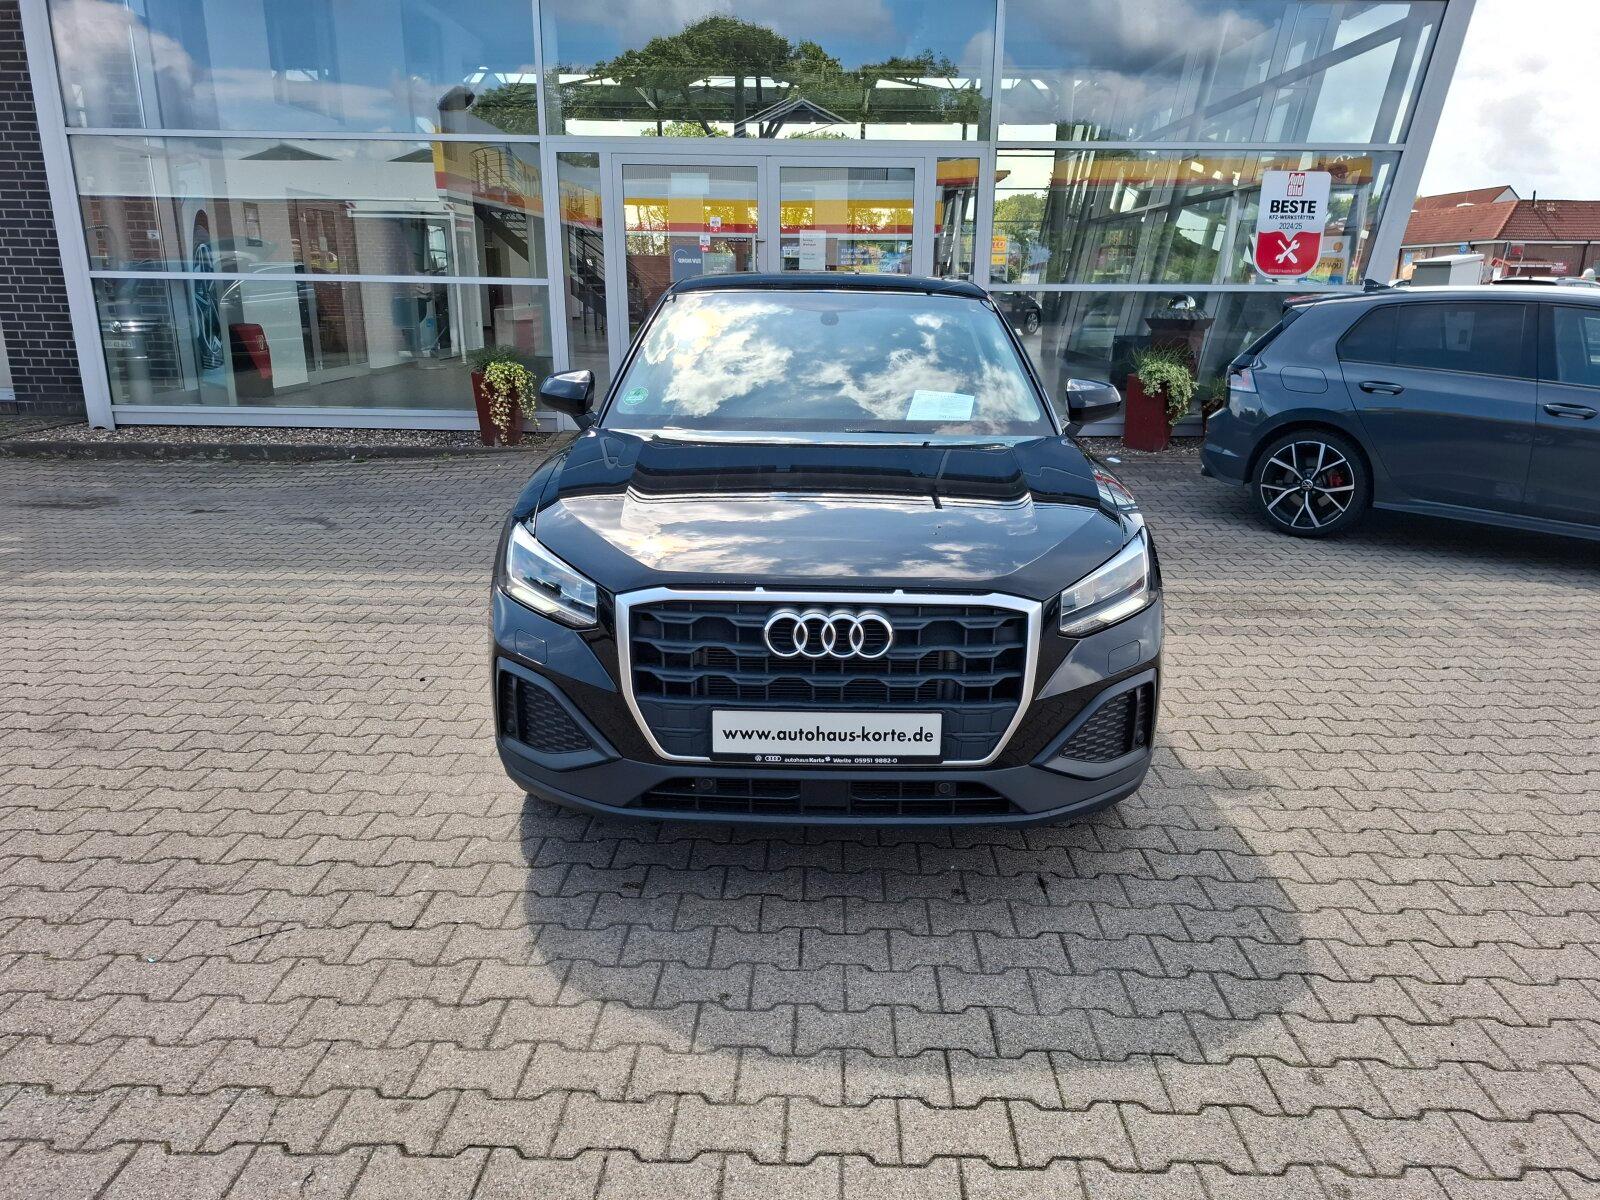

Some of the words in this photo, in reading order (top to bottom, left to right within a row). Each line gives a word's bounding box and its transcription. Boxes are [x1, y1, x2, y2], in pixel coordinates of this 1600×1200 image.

[1288, 173, 1305, 185] Auto
[1287, 185, 1303, 196] Bild
[1270, 200, 1317, 214] BESTE
[722, 726, 934, 743] www.autohaus-korte.de
